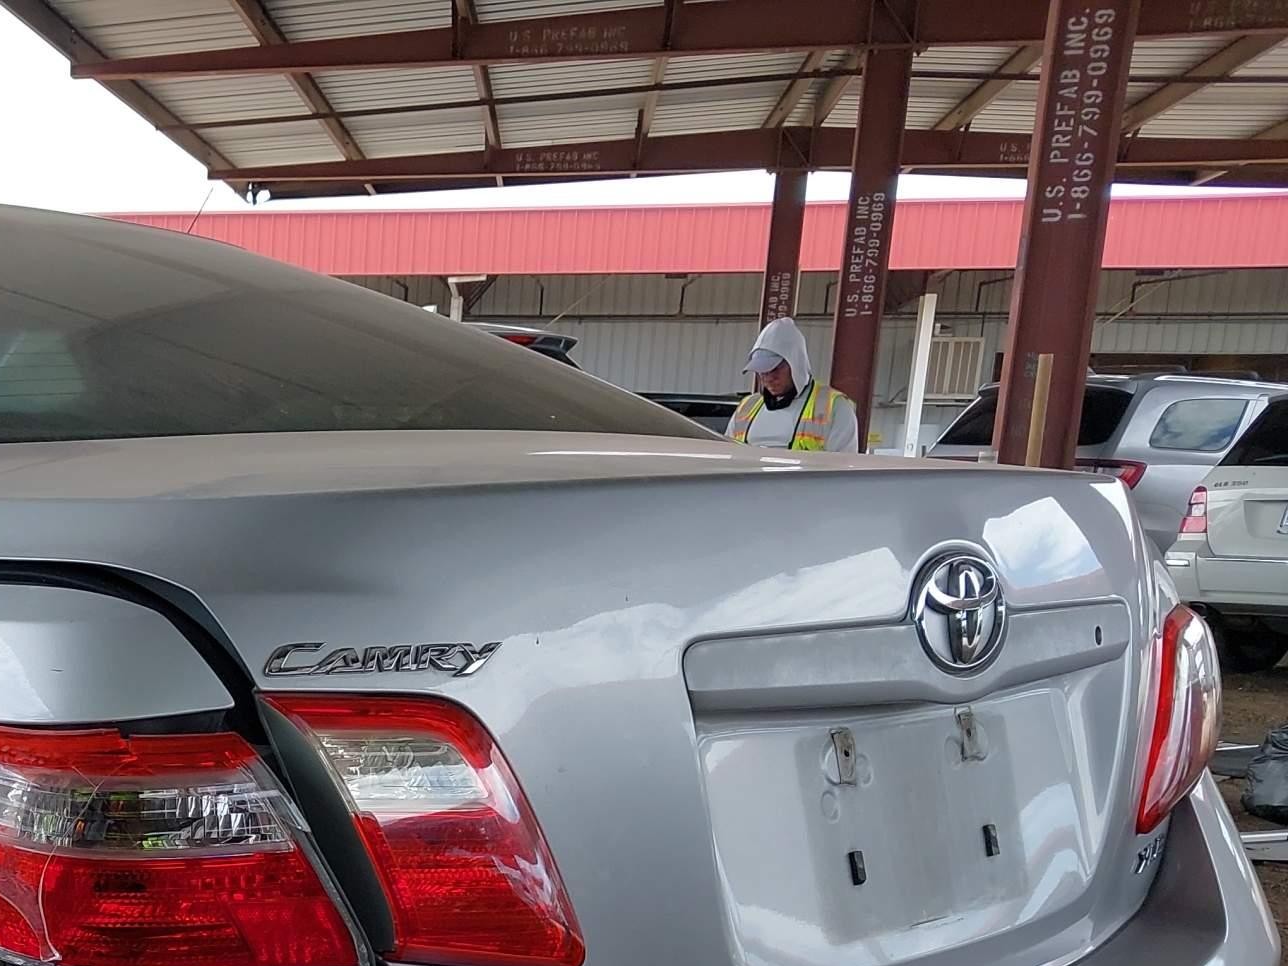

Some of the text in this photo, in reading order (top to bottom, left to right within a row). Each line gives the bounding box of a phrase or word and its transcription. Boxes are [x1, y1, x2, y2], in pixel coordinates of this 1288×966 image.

[1041, 8, 1091, 222] U.S. PREFAB INC.
[1067, 8, 1116, 219] 1-866-799-0969
[848, 226, 867, 282] PREFAB
[860, 192, 886, 315] 1-866-799-0969
